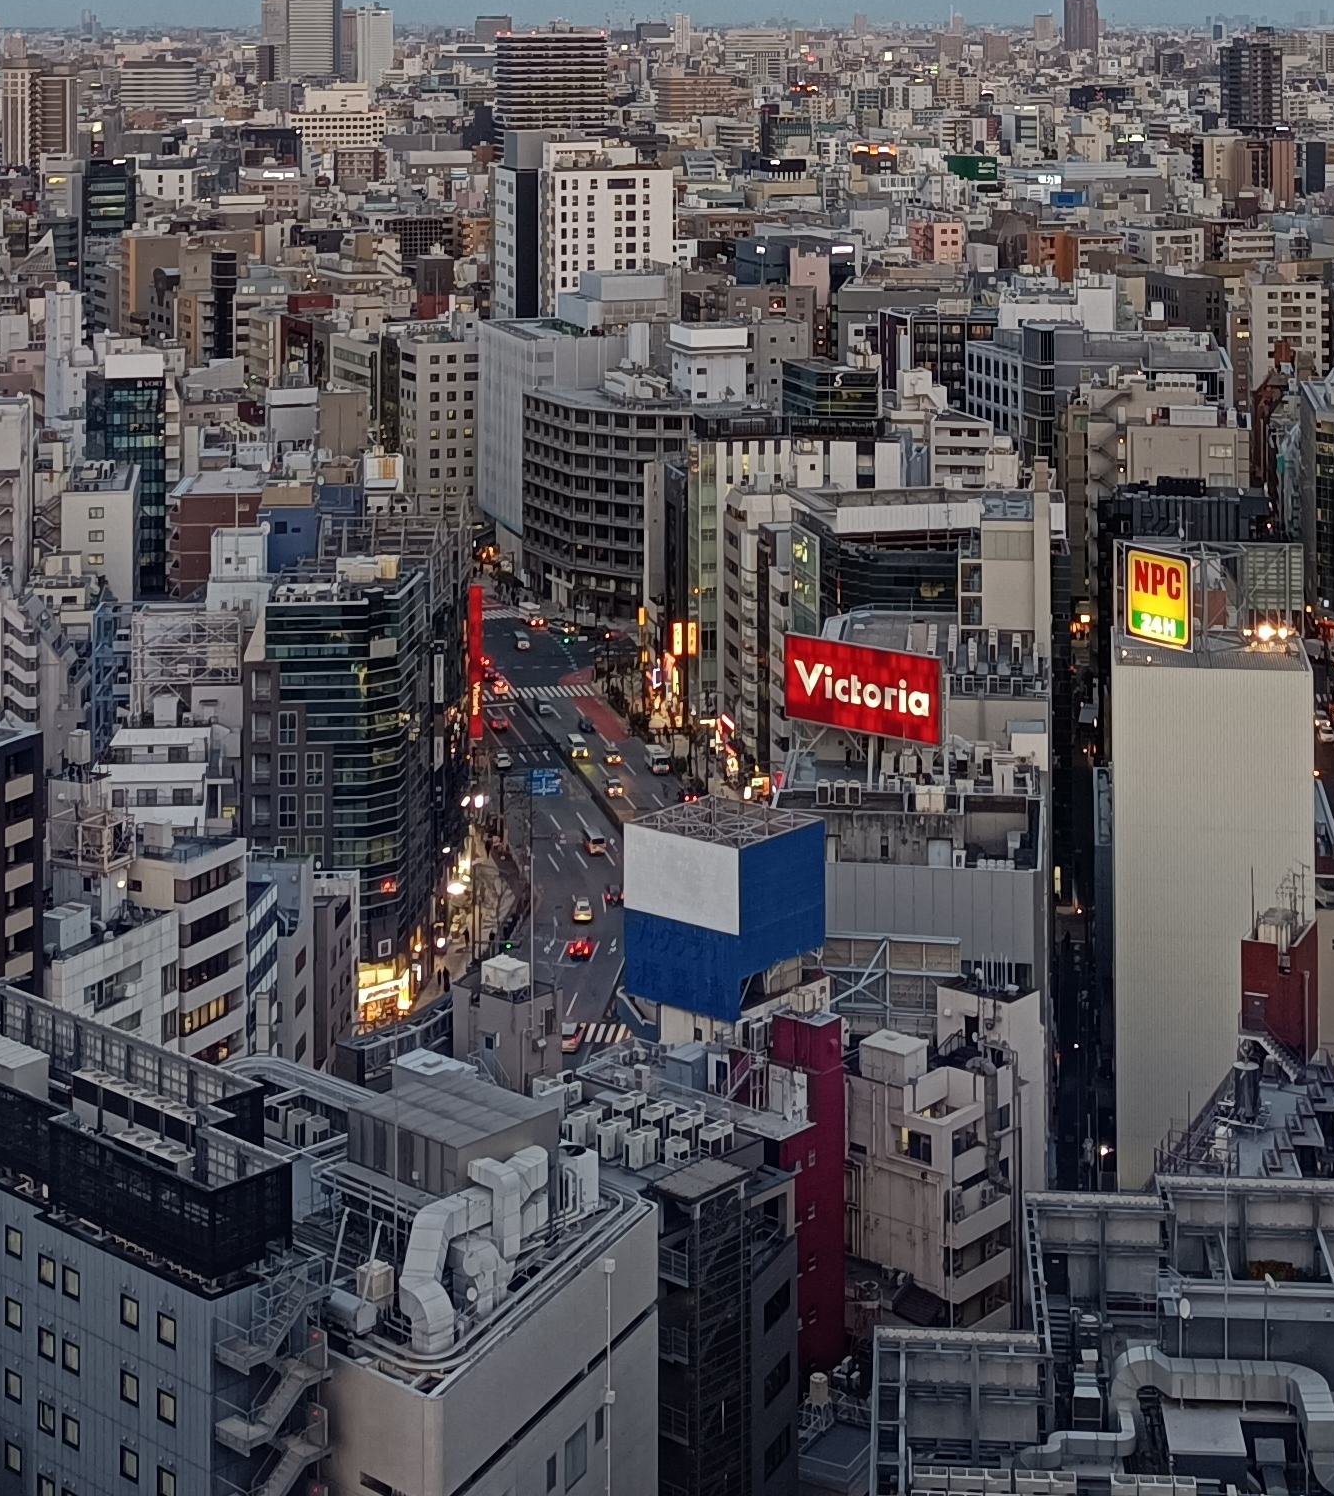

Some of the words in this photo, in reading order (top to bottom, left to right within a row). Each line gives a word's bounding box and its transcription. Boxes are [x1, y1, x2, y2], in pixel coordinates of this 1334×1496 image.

[1134, 559, 1182, 601] NPC
[1140, 612, 1177, 638] 24H
[472, 681, 481, 716] Victoria
[793, 658, 930, 717] Victoria
